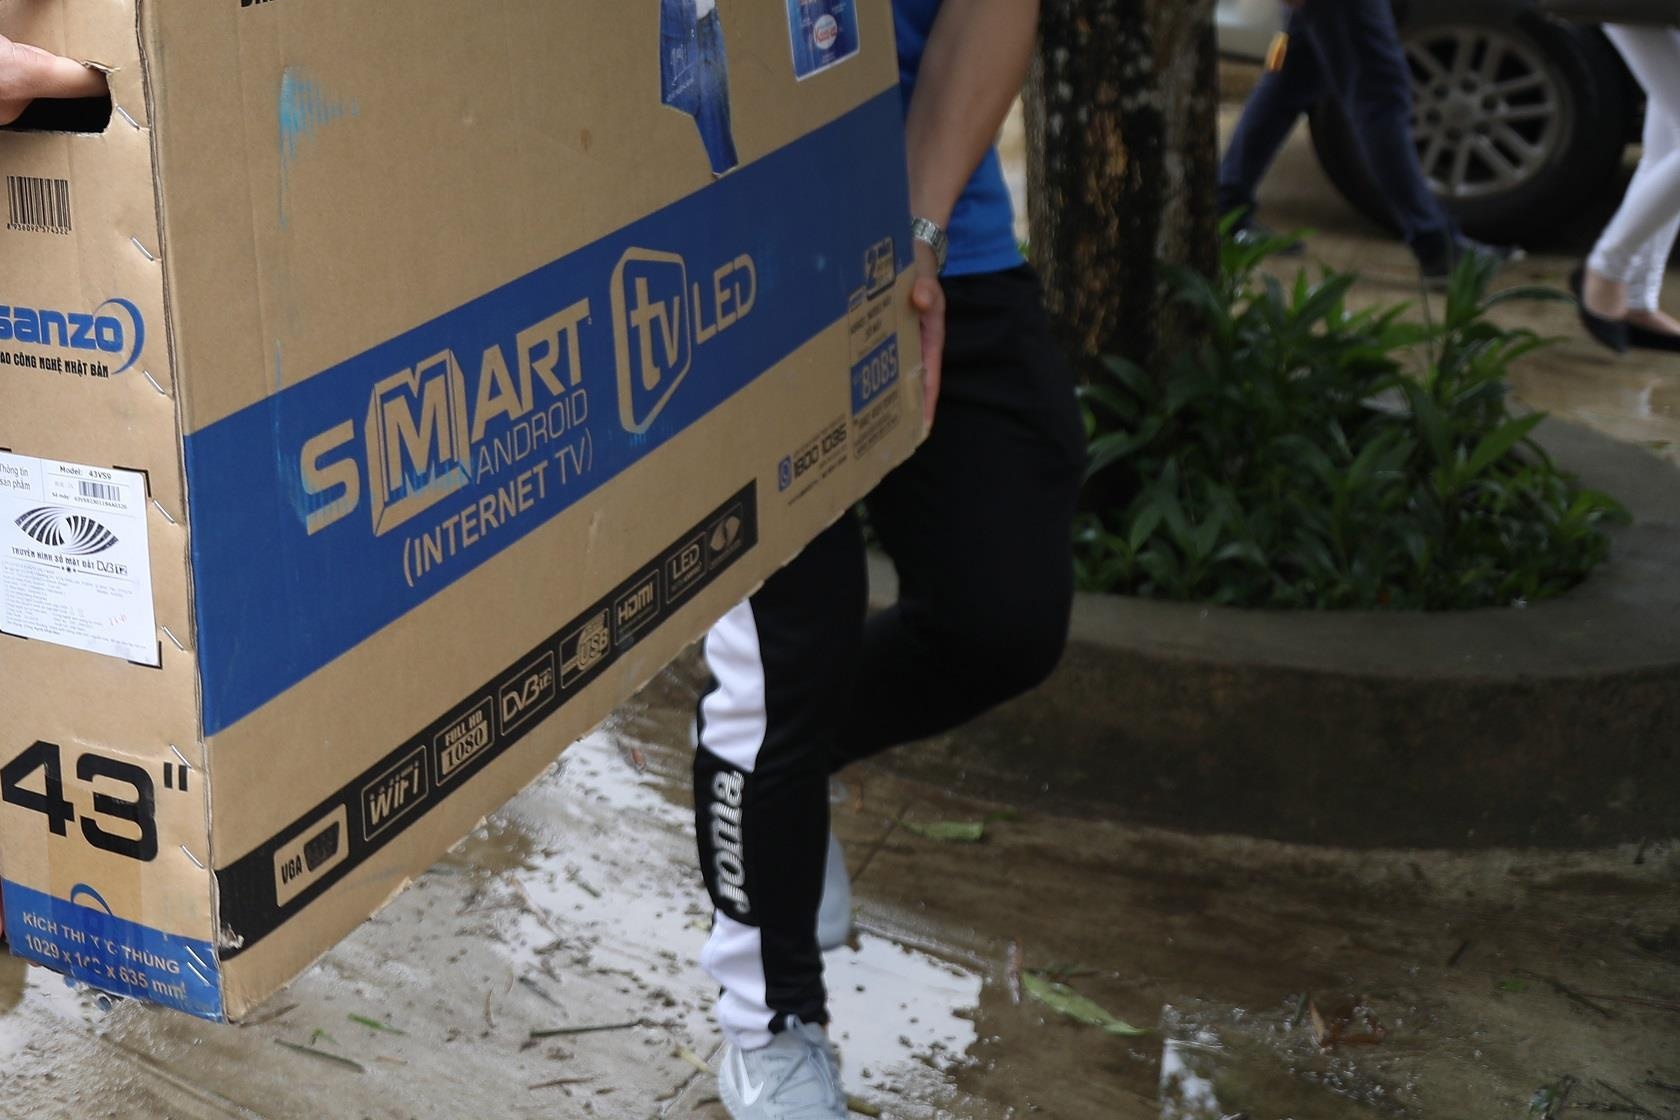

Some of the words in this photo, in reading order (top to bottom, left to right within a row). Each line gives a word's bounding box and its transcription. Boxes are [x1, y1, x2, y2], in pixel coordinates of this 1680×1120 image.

[300, 297, 591, 537] SMART
[693, 253, 757, 345] LED
[476, 388, 588, 485] ANDROID
[403, 460, 549, 588] (INTERNET
[555, 427, 593, 485] TV)
[672, 544, 700, 580] LED
[445, 722, 467, 747] FULL
[446, 727, 483, 768] 1080
[281, 854, 302, 885] VGA
[25, 933, 60, 959] 1029
[119, 965, 149, 989] 635
